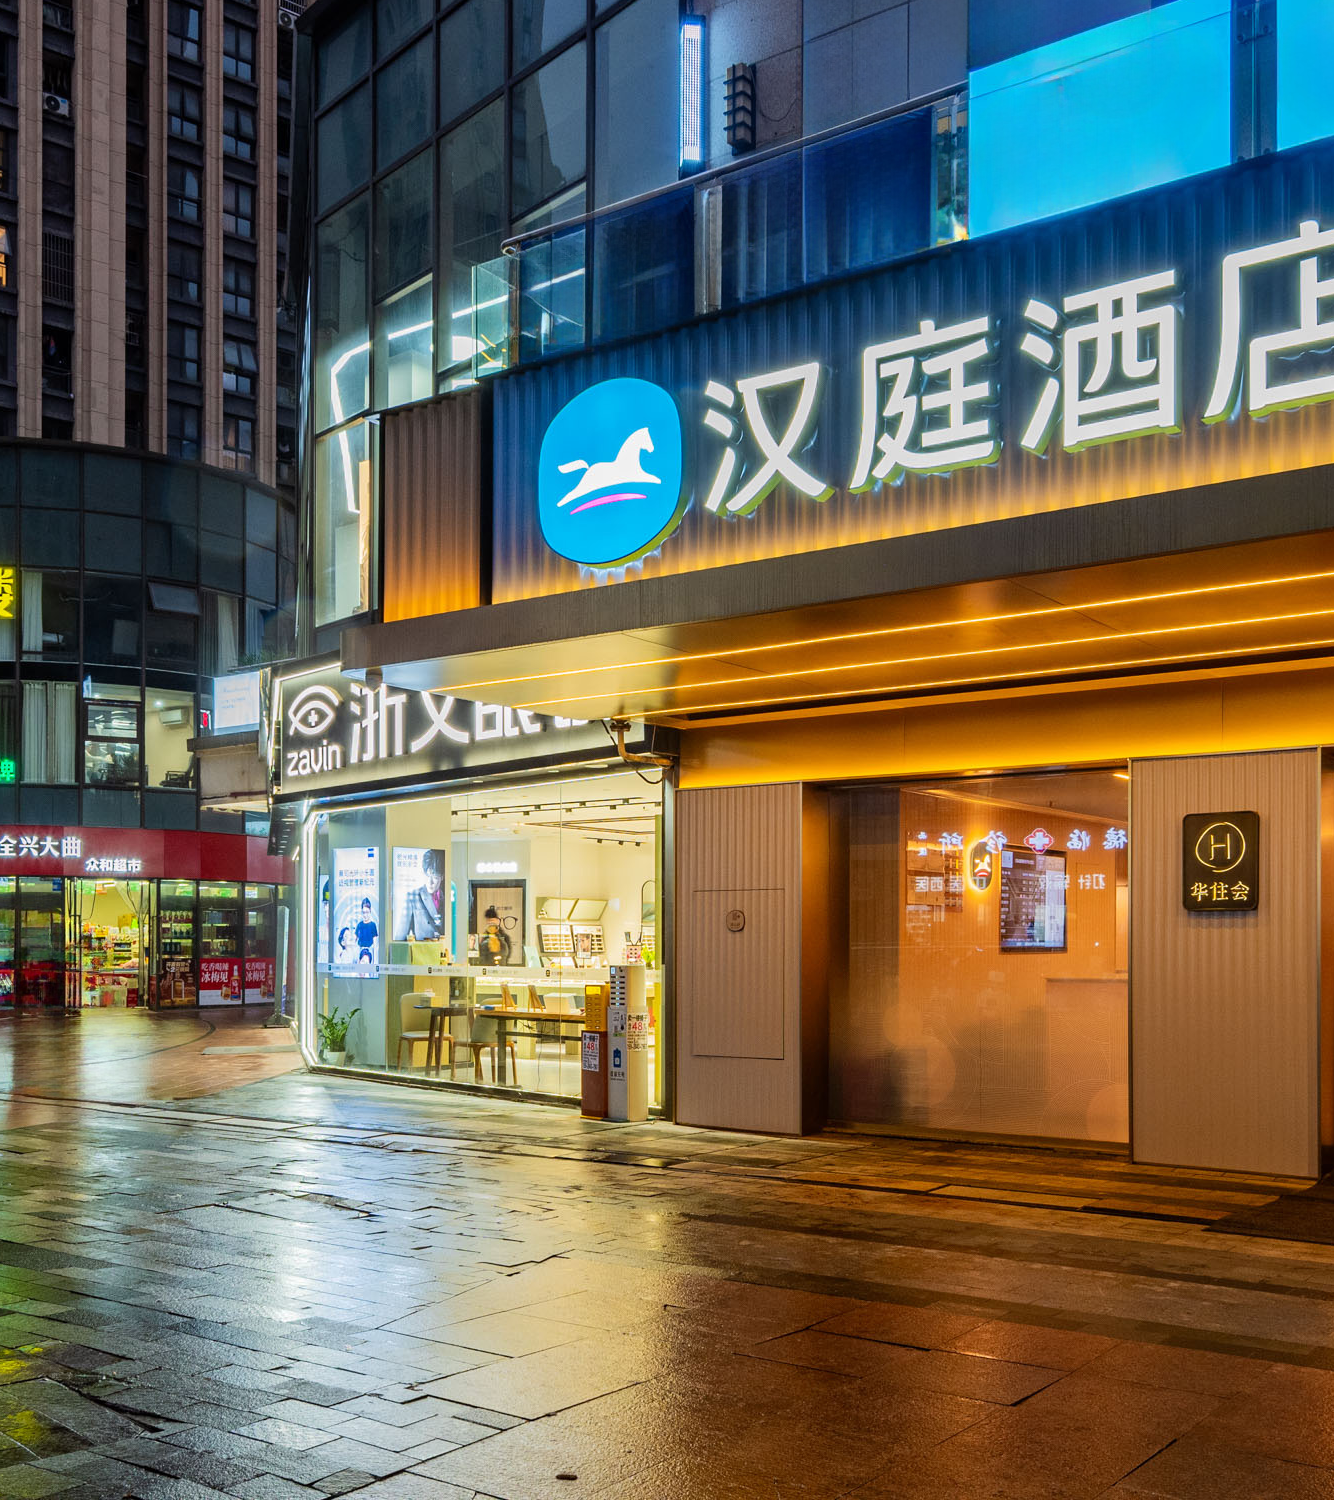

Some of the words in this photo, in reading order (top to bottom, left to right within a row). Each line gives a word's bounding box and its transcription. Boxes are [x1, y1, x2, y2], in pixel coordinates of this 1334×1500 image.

[287, 740, 342, 777] zavin
[85, 857, 142, 872] 众和超市
[1190, 880, 1250, 902] 华住会
[201, 962, 229, 971] 吃香喝辣
[245, 961, 266, 971] 吃香喝辣
[201, 971, 229, 984] 冰梅见
[245, 970, 266, 982] 冰梅见
[632, 1022, 644, 1030] 48
[586, 1042, 595, 1051] 48
